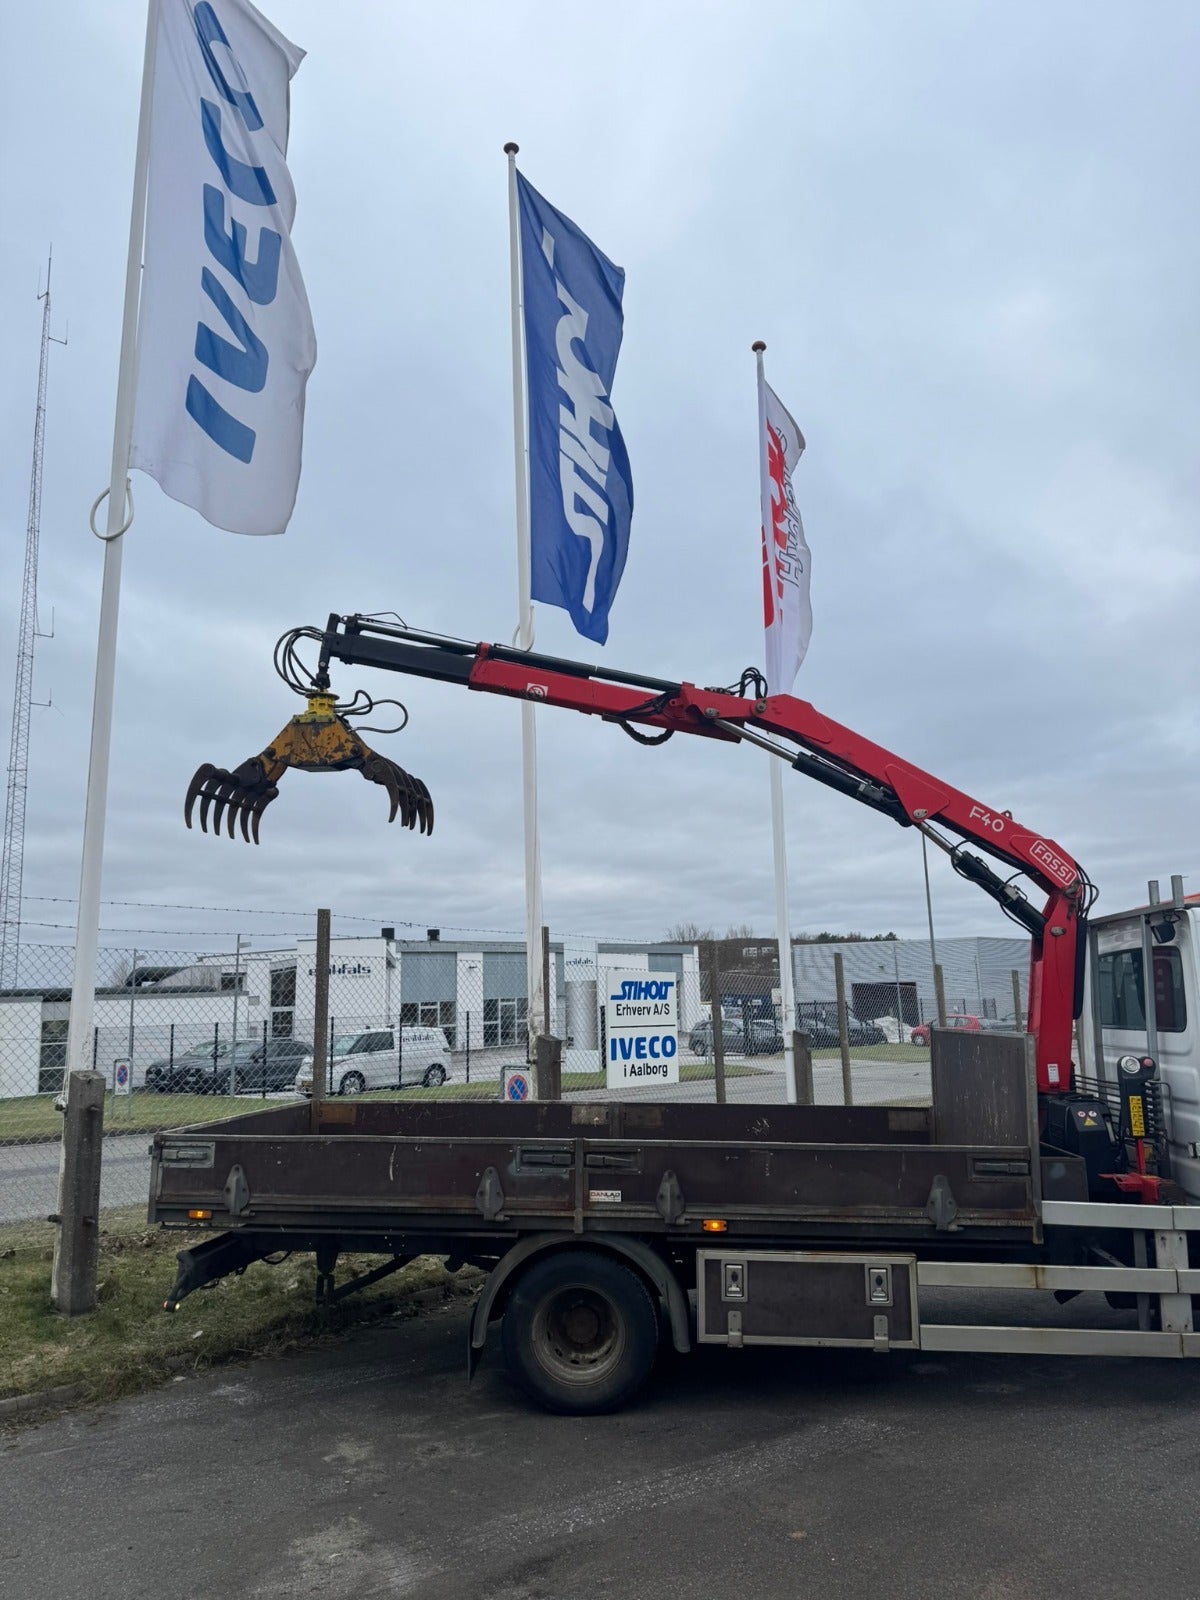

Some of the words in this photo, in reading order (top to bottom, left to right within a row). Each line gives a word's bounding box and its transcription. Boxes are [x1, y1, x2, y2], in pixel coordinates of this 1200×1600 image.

[185, 1, 281, 465] IVECO
[969, 805, 1005, 832] F40
[1034, 844, 1072, 881] FASSI
[610, 980, 675, 1001] STIHOLT
[616, 1003, 651, 1016] Erhverv
[653, 1003, 670, 1015] A/S
[610, 1035, 677, 1061] IVECO
[624, 1064, 627, 1077] i
[630, 1062, 668, 1077] Aalborg
